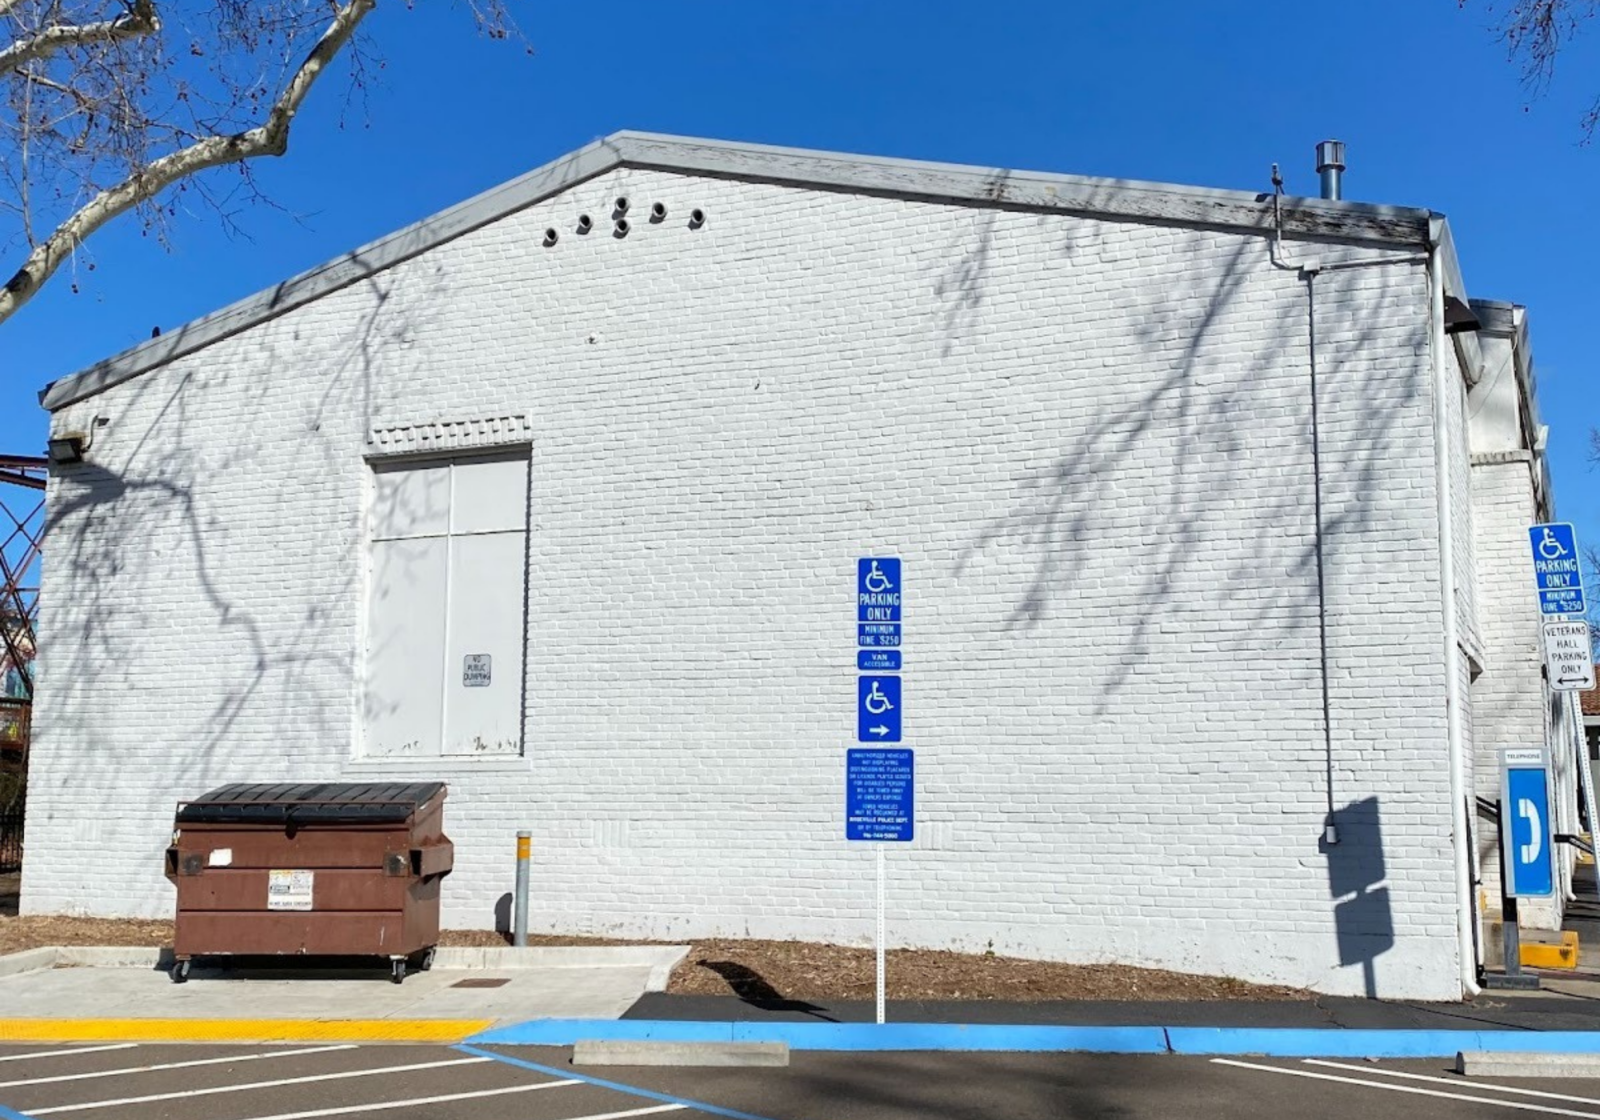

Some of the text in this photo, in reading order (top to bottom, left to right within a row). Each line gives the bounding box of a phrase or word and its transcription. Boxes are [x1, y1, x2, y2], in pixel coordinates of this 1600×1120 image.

[1536, 559, 1577, 573] PARKING
[1546, 574, 1572, 587] ONLY
[859, 592, 900, 606] PARKING
[1546, 590, 1576, 600] MINIMUM
[1543, 601, 1582, 612] FINE $250
[867, 607, 892, 620] ONLY
[864, 625, 895, 634] MINIMUM
[1545, 626, 1586, 637] VETERANS
[860, 635, 899, 645] FINE $250
[1557, 639, 1579, 649] HALL
[473, 655, 481, 663] NO
[871, 653, 888, 661] VAN
[1551, 652, 1587, 662] PARKING
[1561, 664, 1582, 674] ONLY
